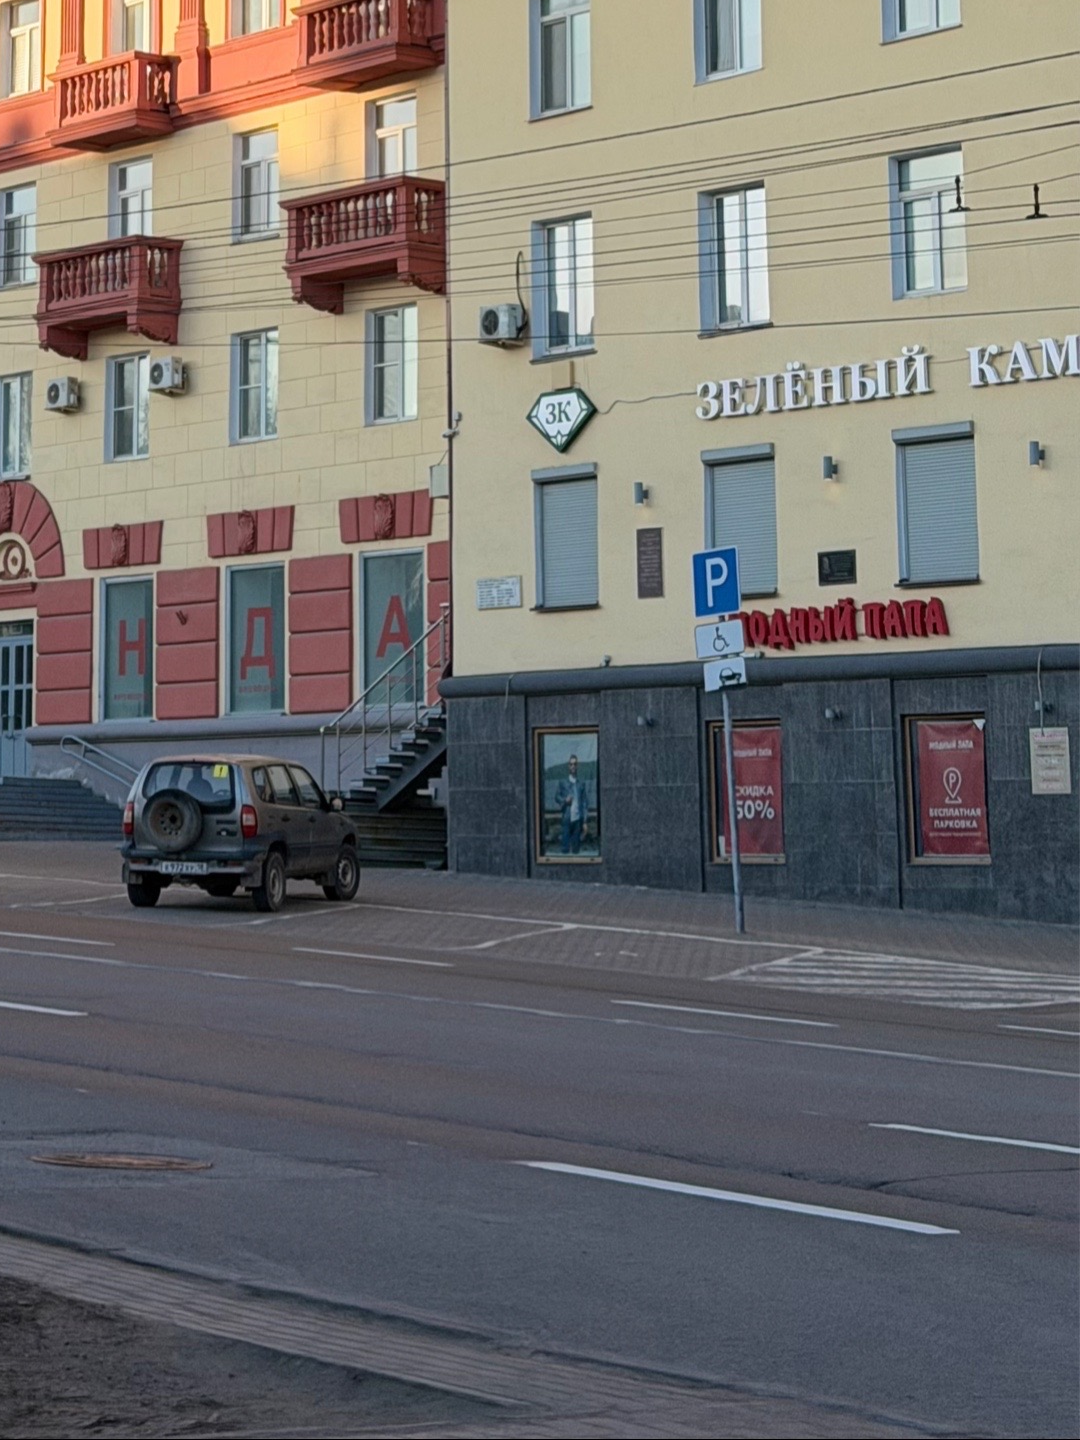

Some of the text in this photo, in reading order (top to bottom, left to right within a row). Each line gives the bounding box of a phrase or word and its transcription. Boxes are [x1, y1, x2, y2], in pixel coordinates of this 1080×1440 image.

[696, 333, 1080, 421] ЗЕЛЁНЫЙ КАМ
[545, 400, 572, 425] ЗК
[705, 557, 728, 608] P
[862, 597, 950, 640] ПАПА
[929, 807, 982, 818] БЕСПЛАТНАЯ
